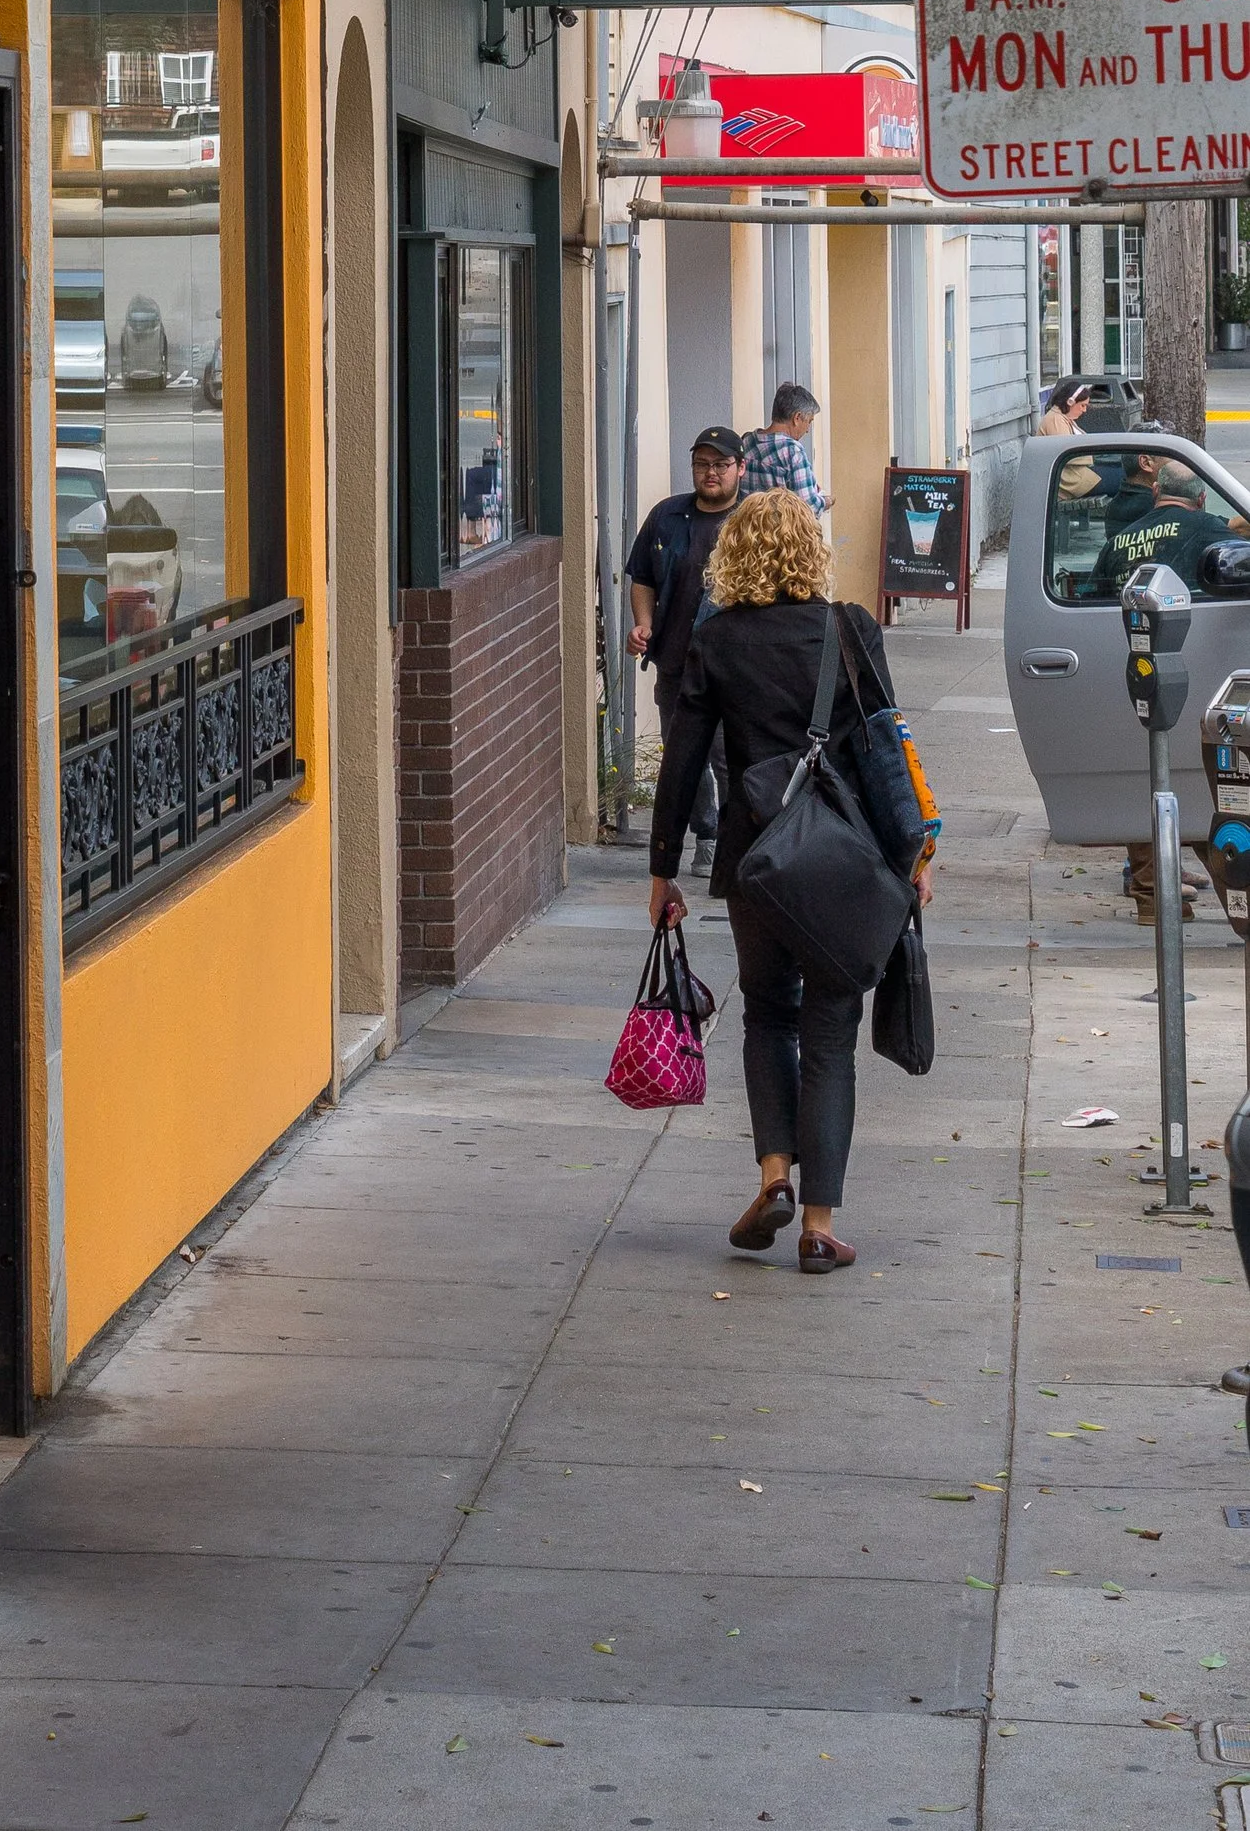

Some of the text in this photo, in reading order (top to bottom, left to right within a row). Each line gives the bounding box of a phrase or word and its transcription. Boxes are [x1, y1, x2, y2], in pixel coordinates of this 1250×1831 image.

[950, 30, 1066, 93] MON
[1079, 55, 1138, 87] AND
[960, 140, 1094, 181] STREET
[903, 484, 935, 492] MATCHA
[908, 476, 957, 485] STRAWBERRY
[928, 500, 945, 510] TEA
[1113, 522, 1180, 551] TULLAMORE
[1127, 540, 1155, 561] DEW
[891, 558, 907, 566] REAL
